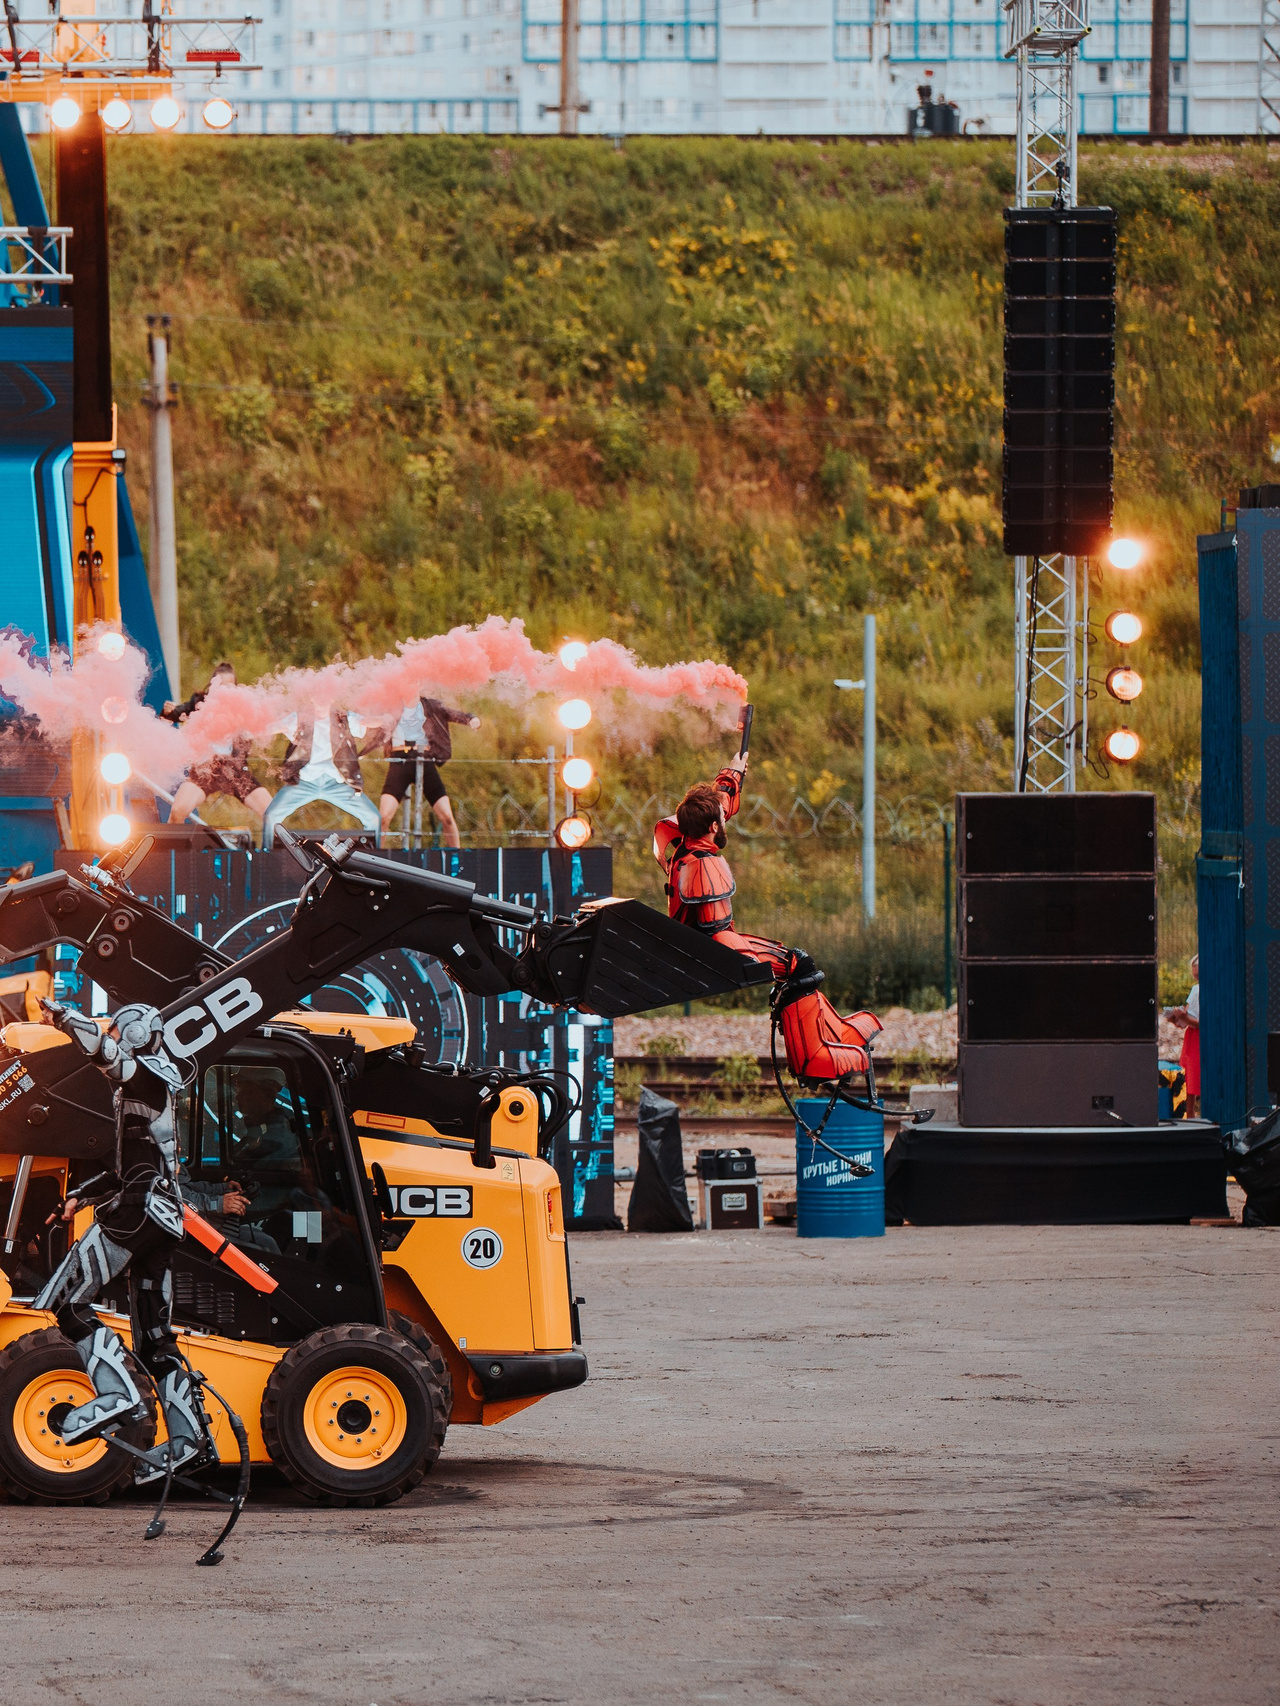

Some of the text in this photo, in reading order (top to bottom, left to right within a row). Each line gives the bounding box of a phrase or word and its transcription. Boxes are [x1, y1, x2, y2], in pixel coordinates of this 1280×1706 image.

[163, 977, 263, 1058] CB
[5, 1079, 13, 1087] 5
[12, 1066, 28, 1080] 066
[803, 1160, 838, 1179] КРУТЫЕ
[469, 1238, 495, 1259] 20
